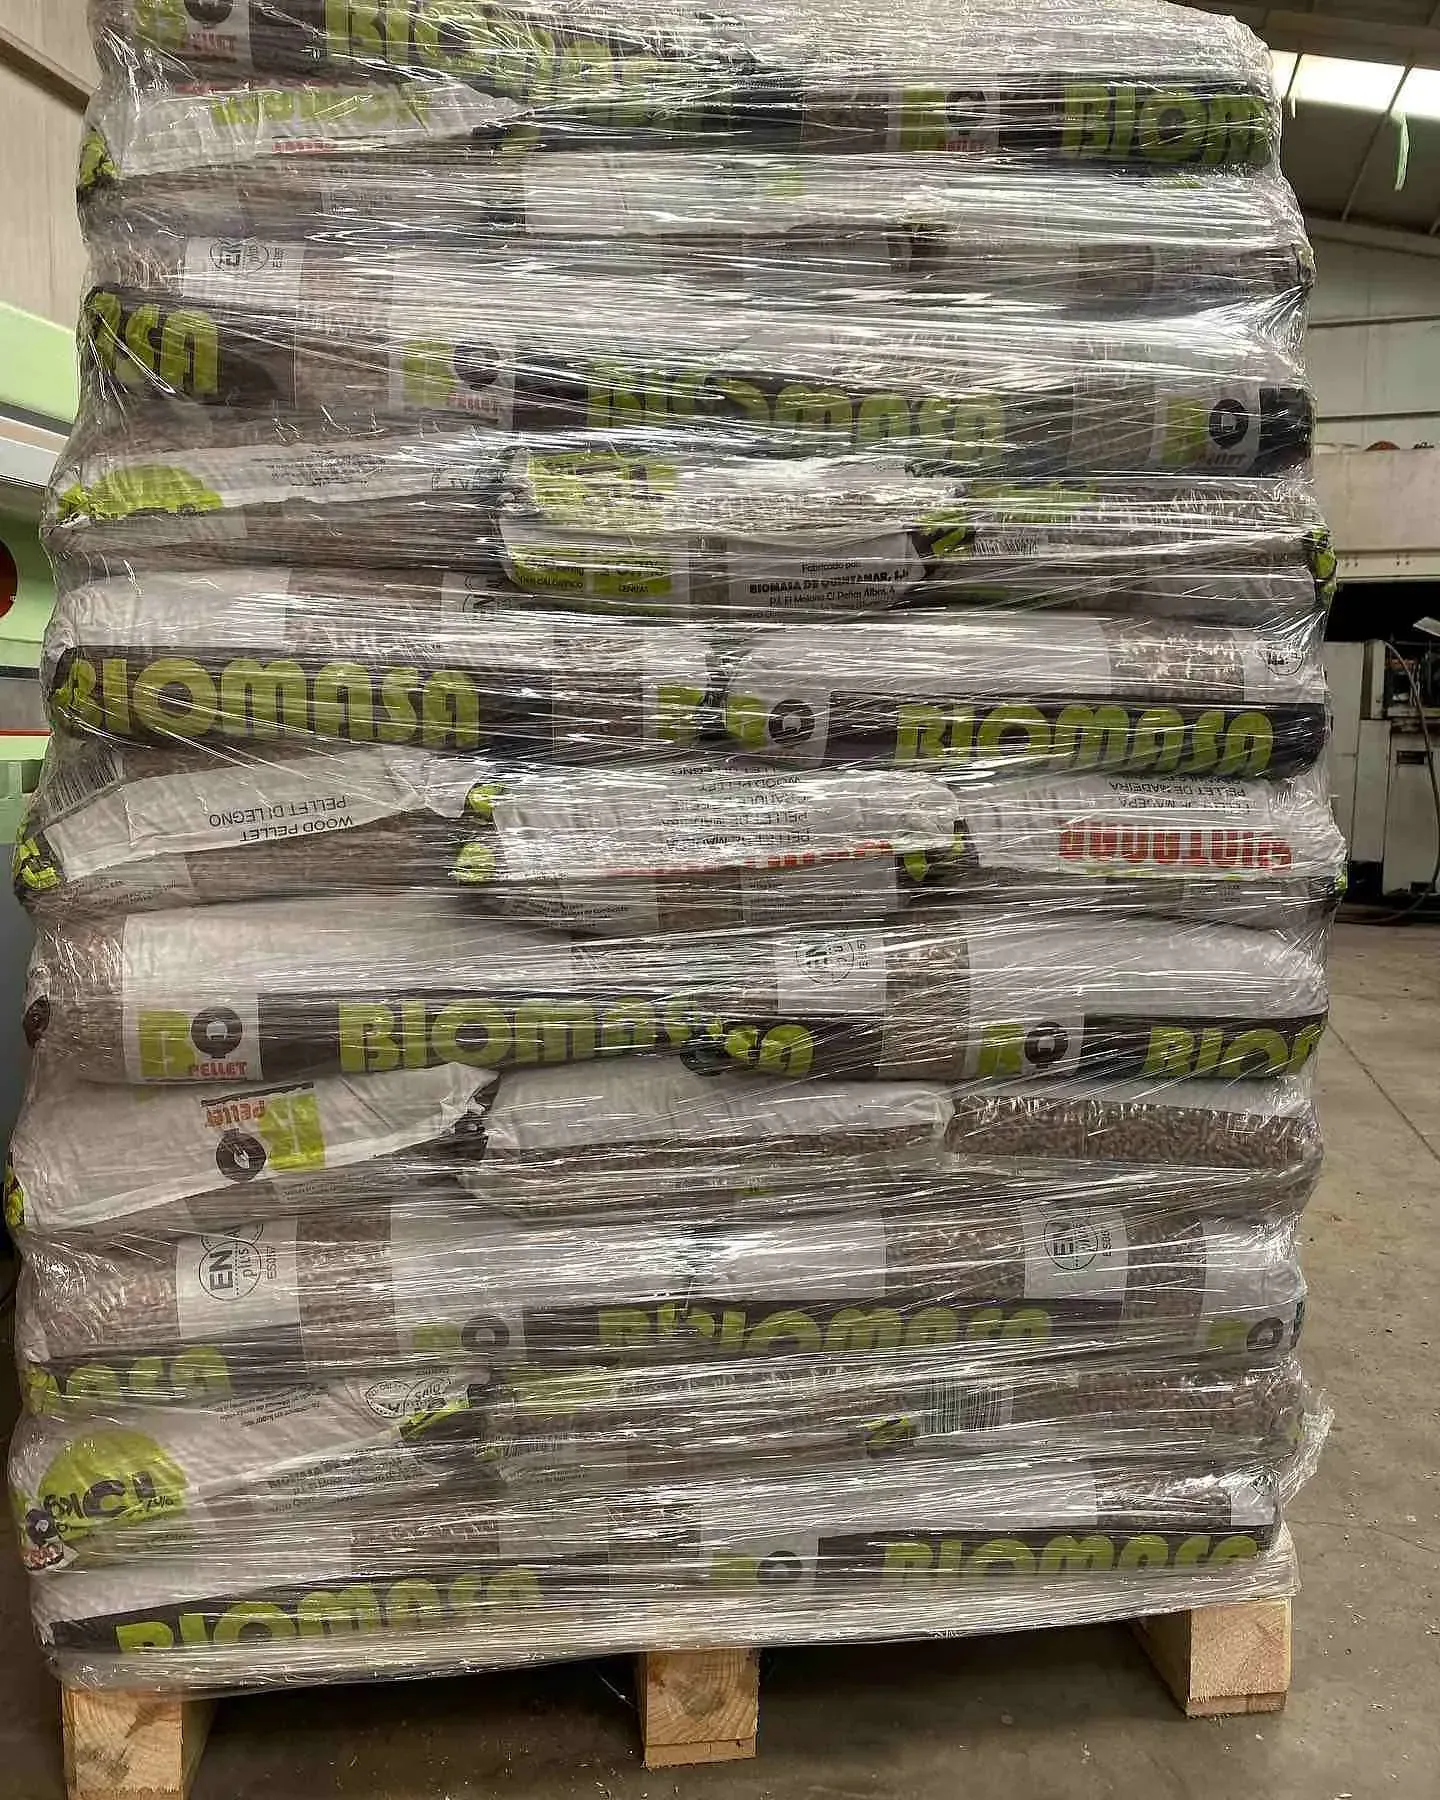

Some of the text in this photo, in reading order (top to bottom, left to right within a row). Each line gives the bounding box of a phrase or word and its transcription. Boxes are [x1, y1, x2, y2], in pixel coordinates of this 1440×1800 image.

[209, 795, 347, 828] PELLET DI LEGNO
[239, 814, 354, 843] WOOD PELLET
[187, 1060, 248, 1077] PELLET
[208, 1249, 233, 1290] EN
